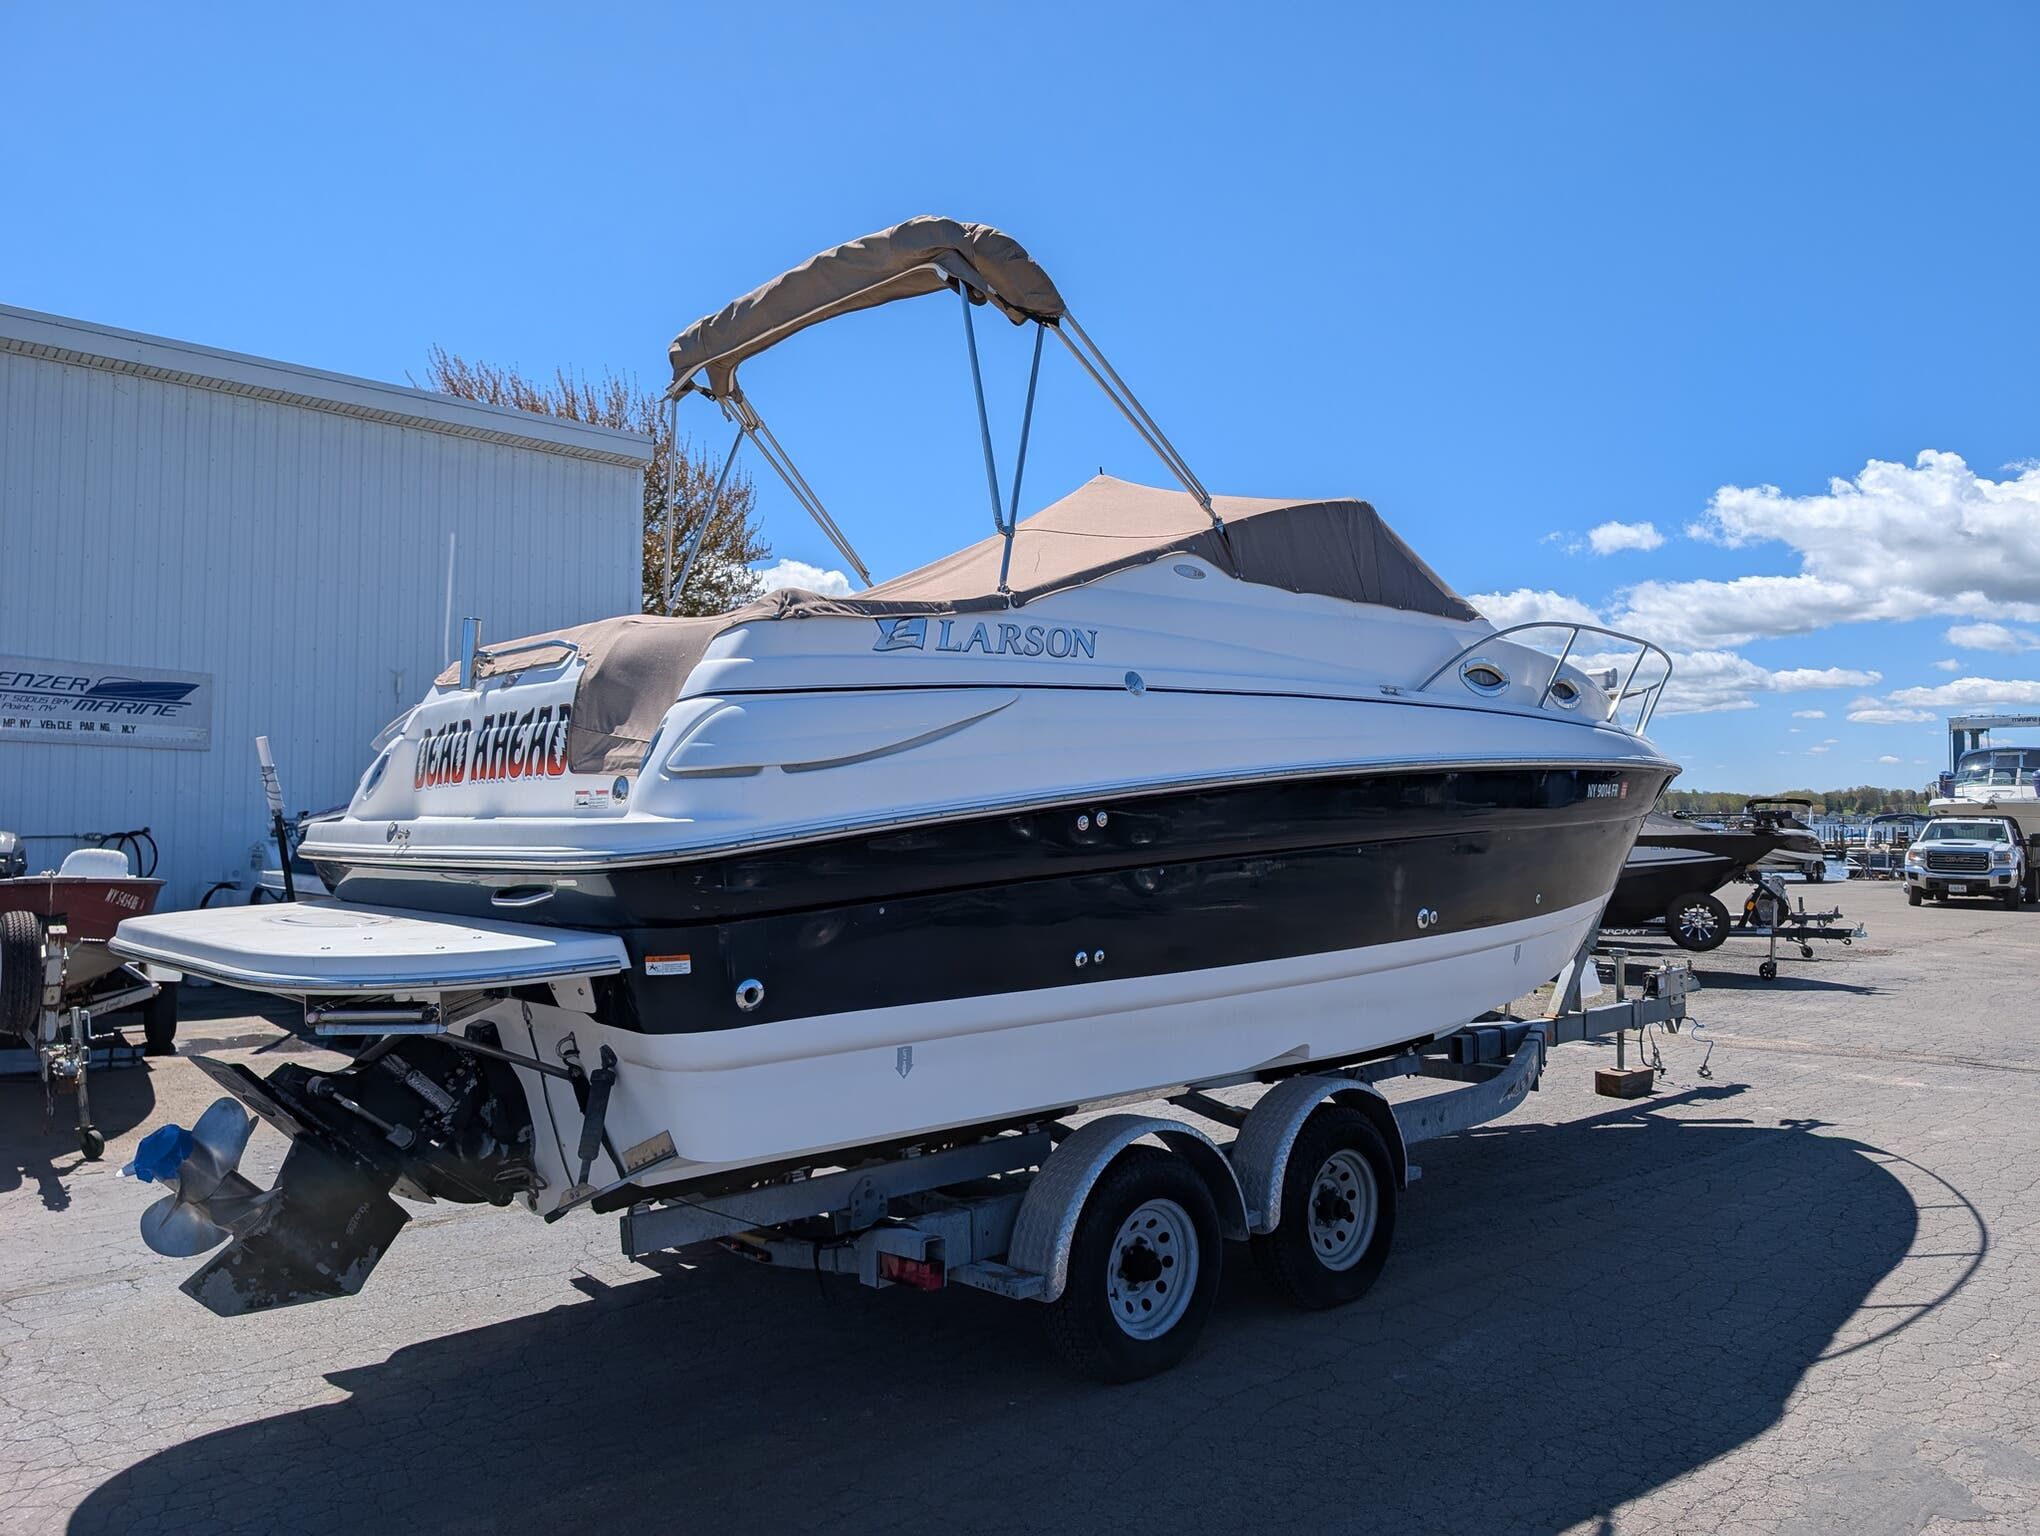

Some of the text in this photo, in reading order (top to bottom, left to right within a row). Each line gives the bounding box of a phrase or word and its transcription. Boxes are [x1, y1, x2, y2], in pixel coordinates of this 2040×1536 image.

[935, 618, 1098, 659] LARSON
[51, 697, 73, 706] BAY
[72, 699, 183, 717] MARINE
[414, 703, 573, 791] DEAD AHEAD
[1587, 783, 1597, 798] NY
